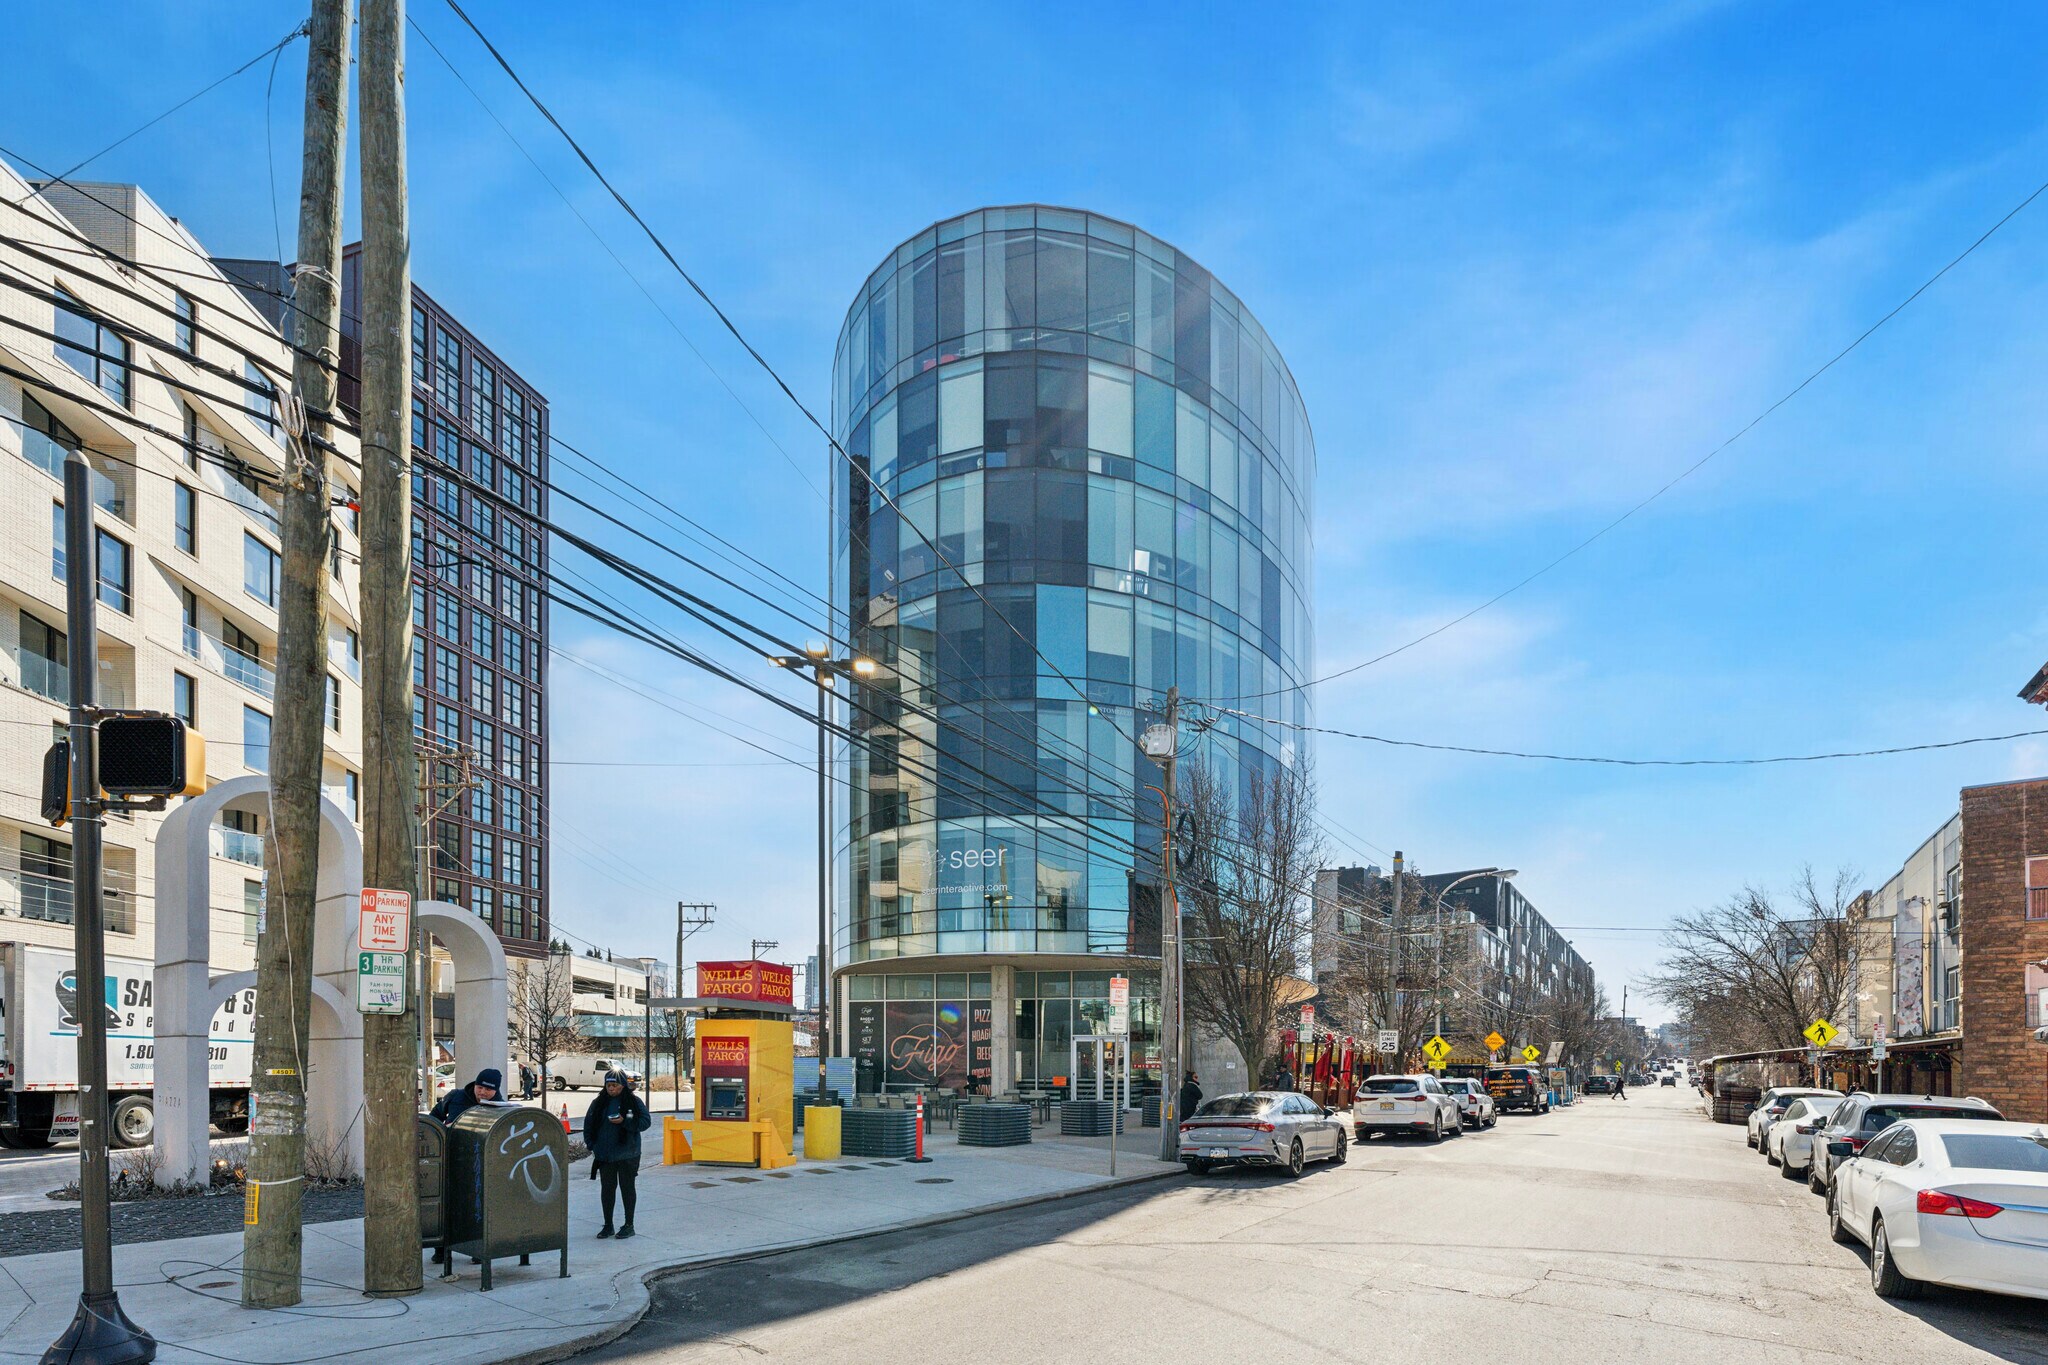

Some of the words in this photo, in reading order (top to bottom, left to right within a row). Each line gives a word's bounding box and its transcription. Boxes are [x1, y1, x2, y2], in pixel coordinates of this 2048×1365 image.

[950, 848, 1008, 868] seer
[923, 883, 1008, 895] seerinteractive.com
[362, 895, 375, 907] NO
[377, 897, 407, 908] PARKING
[374, 914, 395, 925] ANY
[373, 925, 396, 936] TIME
[362, 956, 370, 971] 3
[381, 955, 393, 964] HR
[373, 965, 403, 975] PARKING
[702, 969, 753, 982] WELLS
[760, 970, 790, 985] WELLS
[703, 982, 753, 994] FARGO
[761, 984, 790, 998] FARGO
[706, 1041, 745, 1051] WELLS
[1381, 1042, 1396, 1051] 25
[707, 1051, 745, 1061] FARGO
[891, 1035, 964, 1070] Figo
